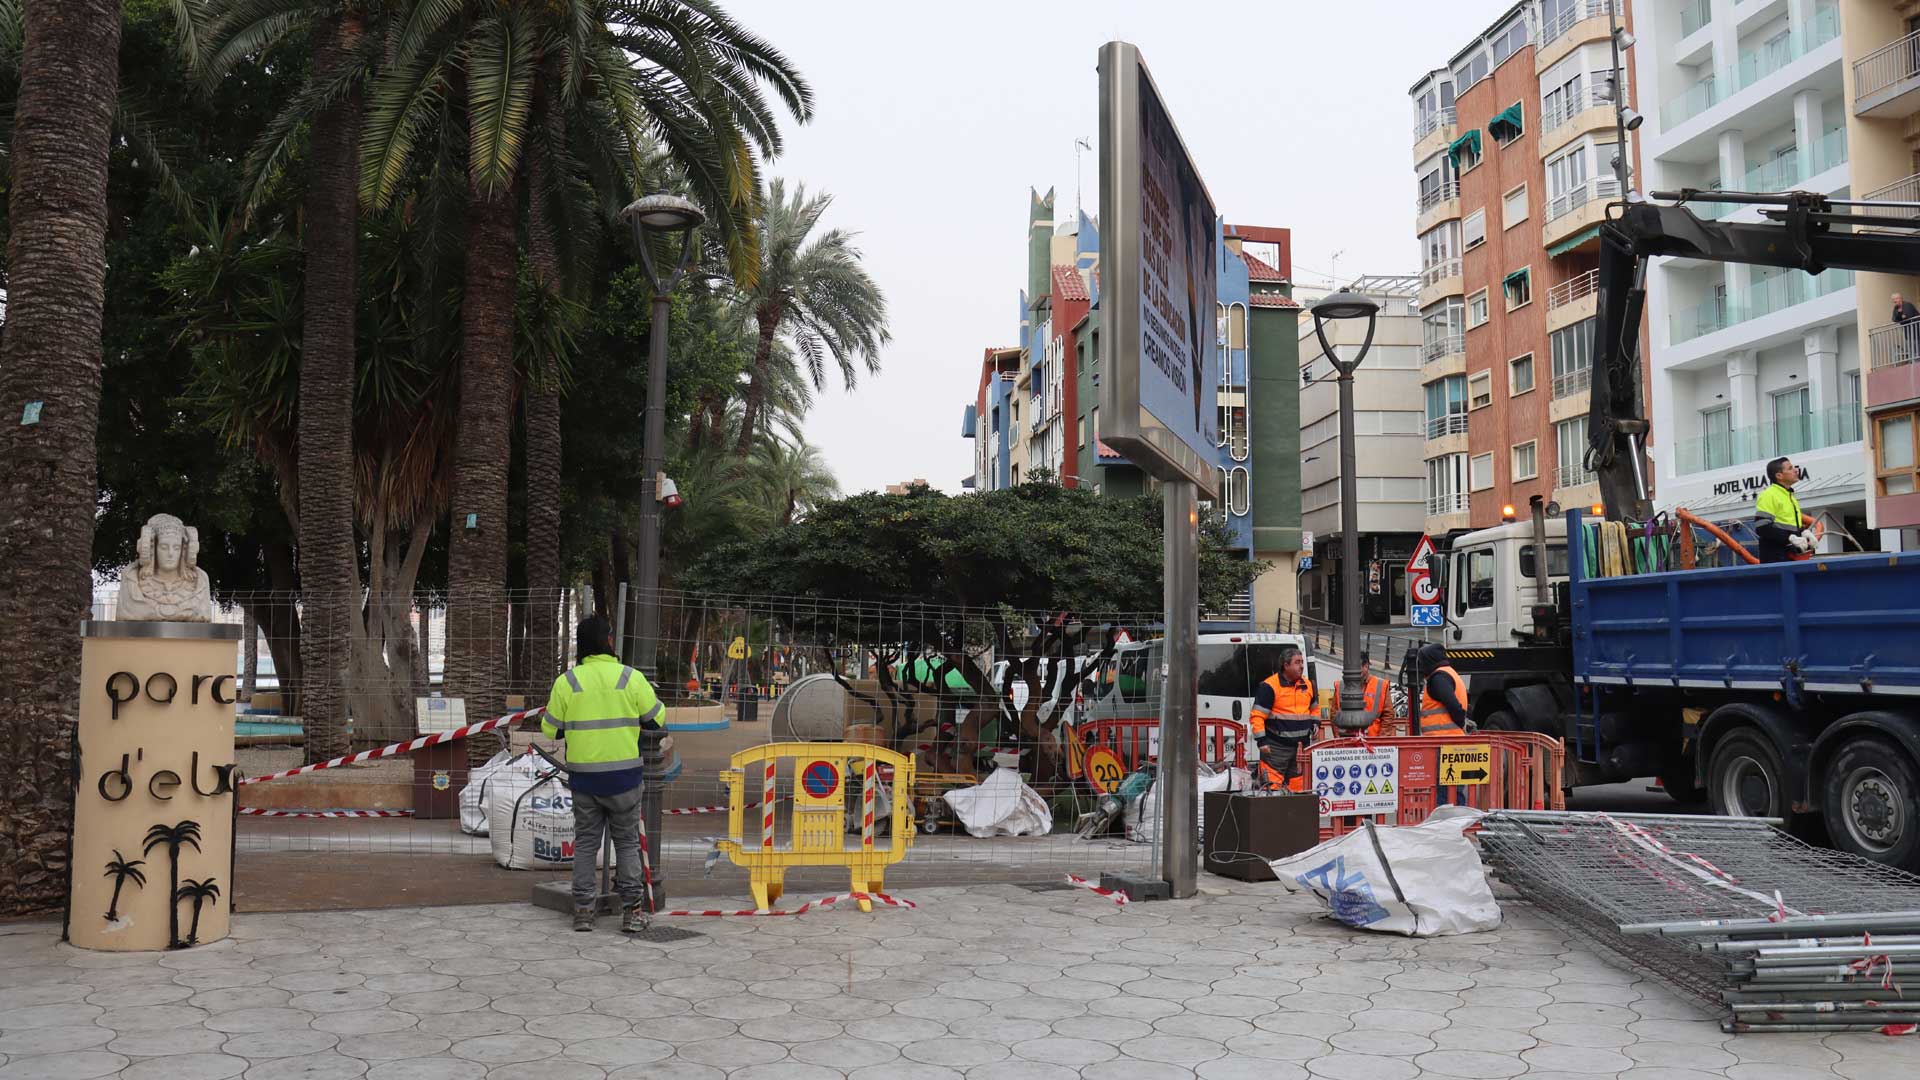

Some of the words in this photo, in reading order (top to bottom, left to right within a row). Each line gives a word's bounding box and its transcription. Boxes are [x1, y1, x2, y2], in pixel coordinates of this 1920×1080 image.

[1143, 196, 1150, 229] LO
[1151, 209, 1162, 248] QUE
[1143, 268, 1151, 300] DE
[1152, 278, 1159, 312] LA
[1144, 331, 1170, 379] CREAMOS
[1714, 481, 1742, 495] HOTEL
[1742, 475, 1768, 490] VILLA
[1421, 583, 1433, 594] 10
[1442, 752, 1489, 763] PEATONES
[1095, 764, 1120, 781] 20
